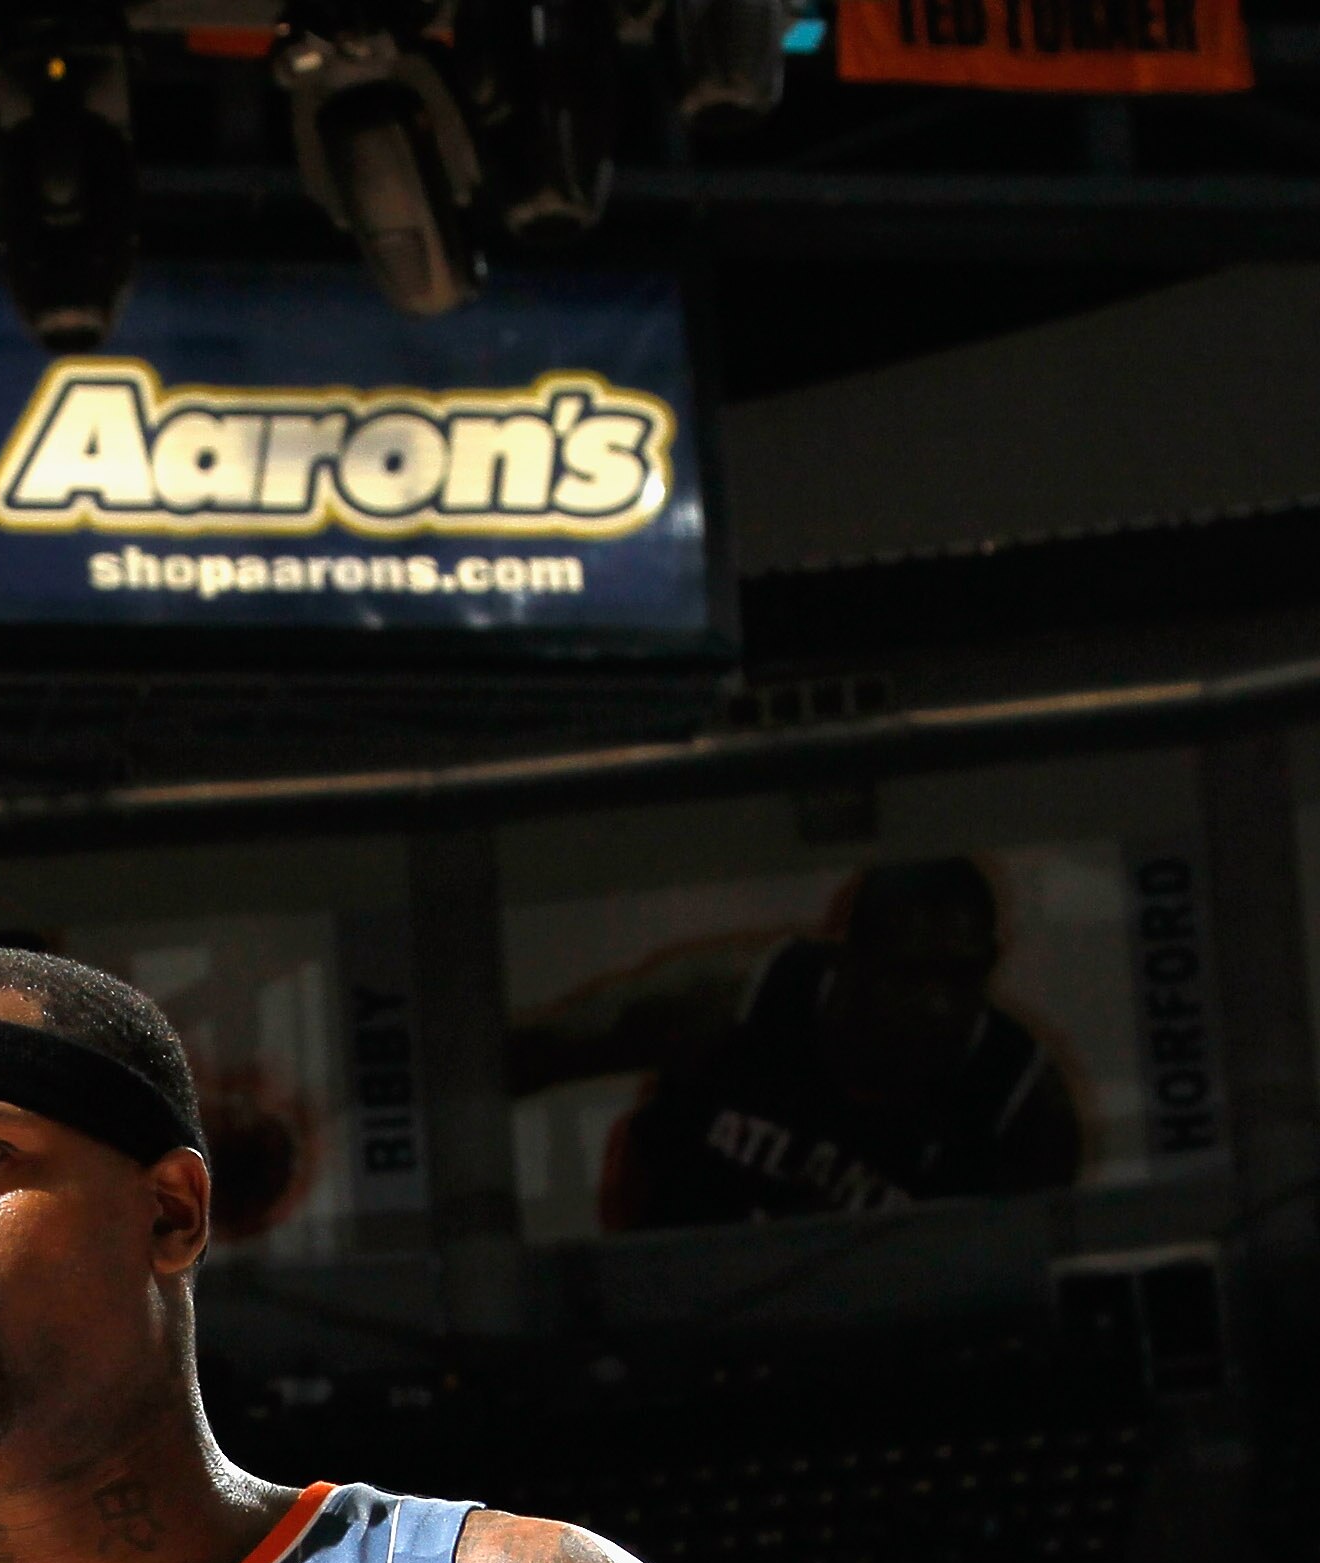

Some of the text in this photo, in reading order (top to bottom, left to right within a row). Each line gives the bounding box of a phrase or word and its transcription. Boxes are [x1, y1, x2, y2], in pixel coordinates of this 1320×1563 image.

[2, 376, 660, 519] Aaron's
[88, 544, 585, 600] shopaarons.com
[1134, 858, 1214, 1154] HORFORD
[352, 987, 416, 1174] BIBBY
[705, 1108, 914, 1212] ATLAN
